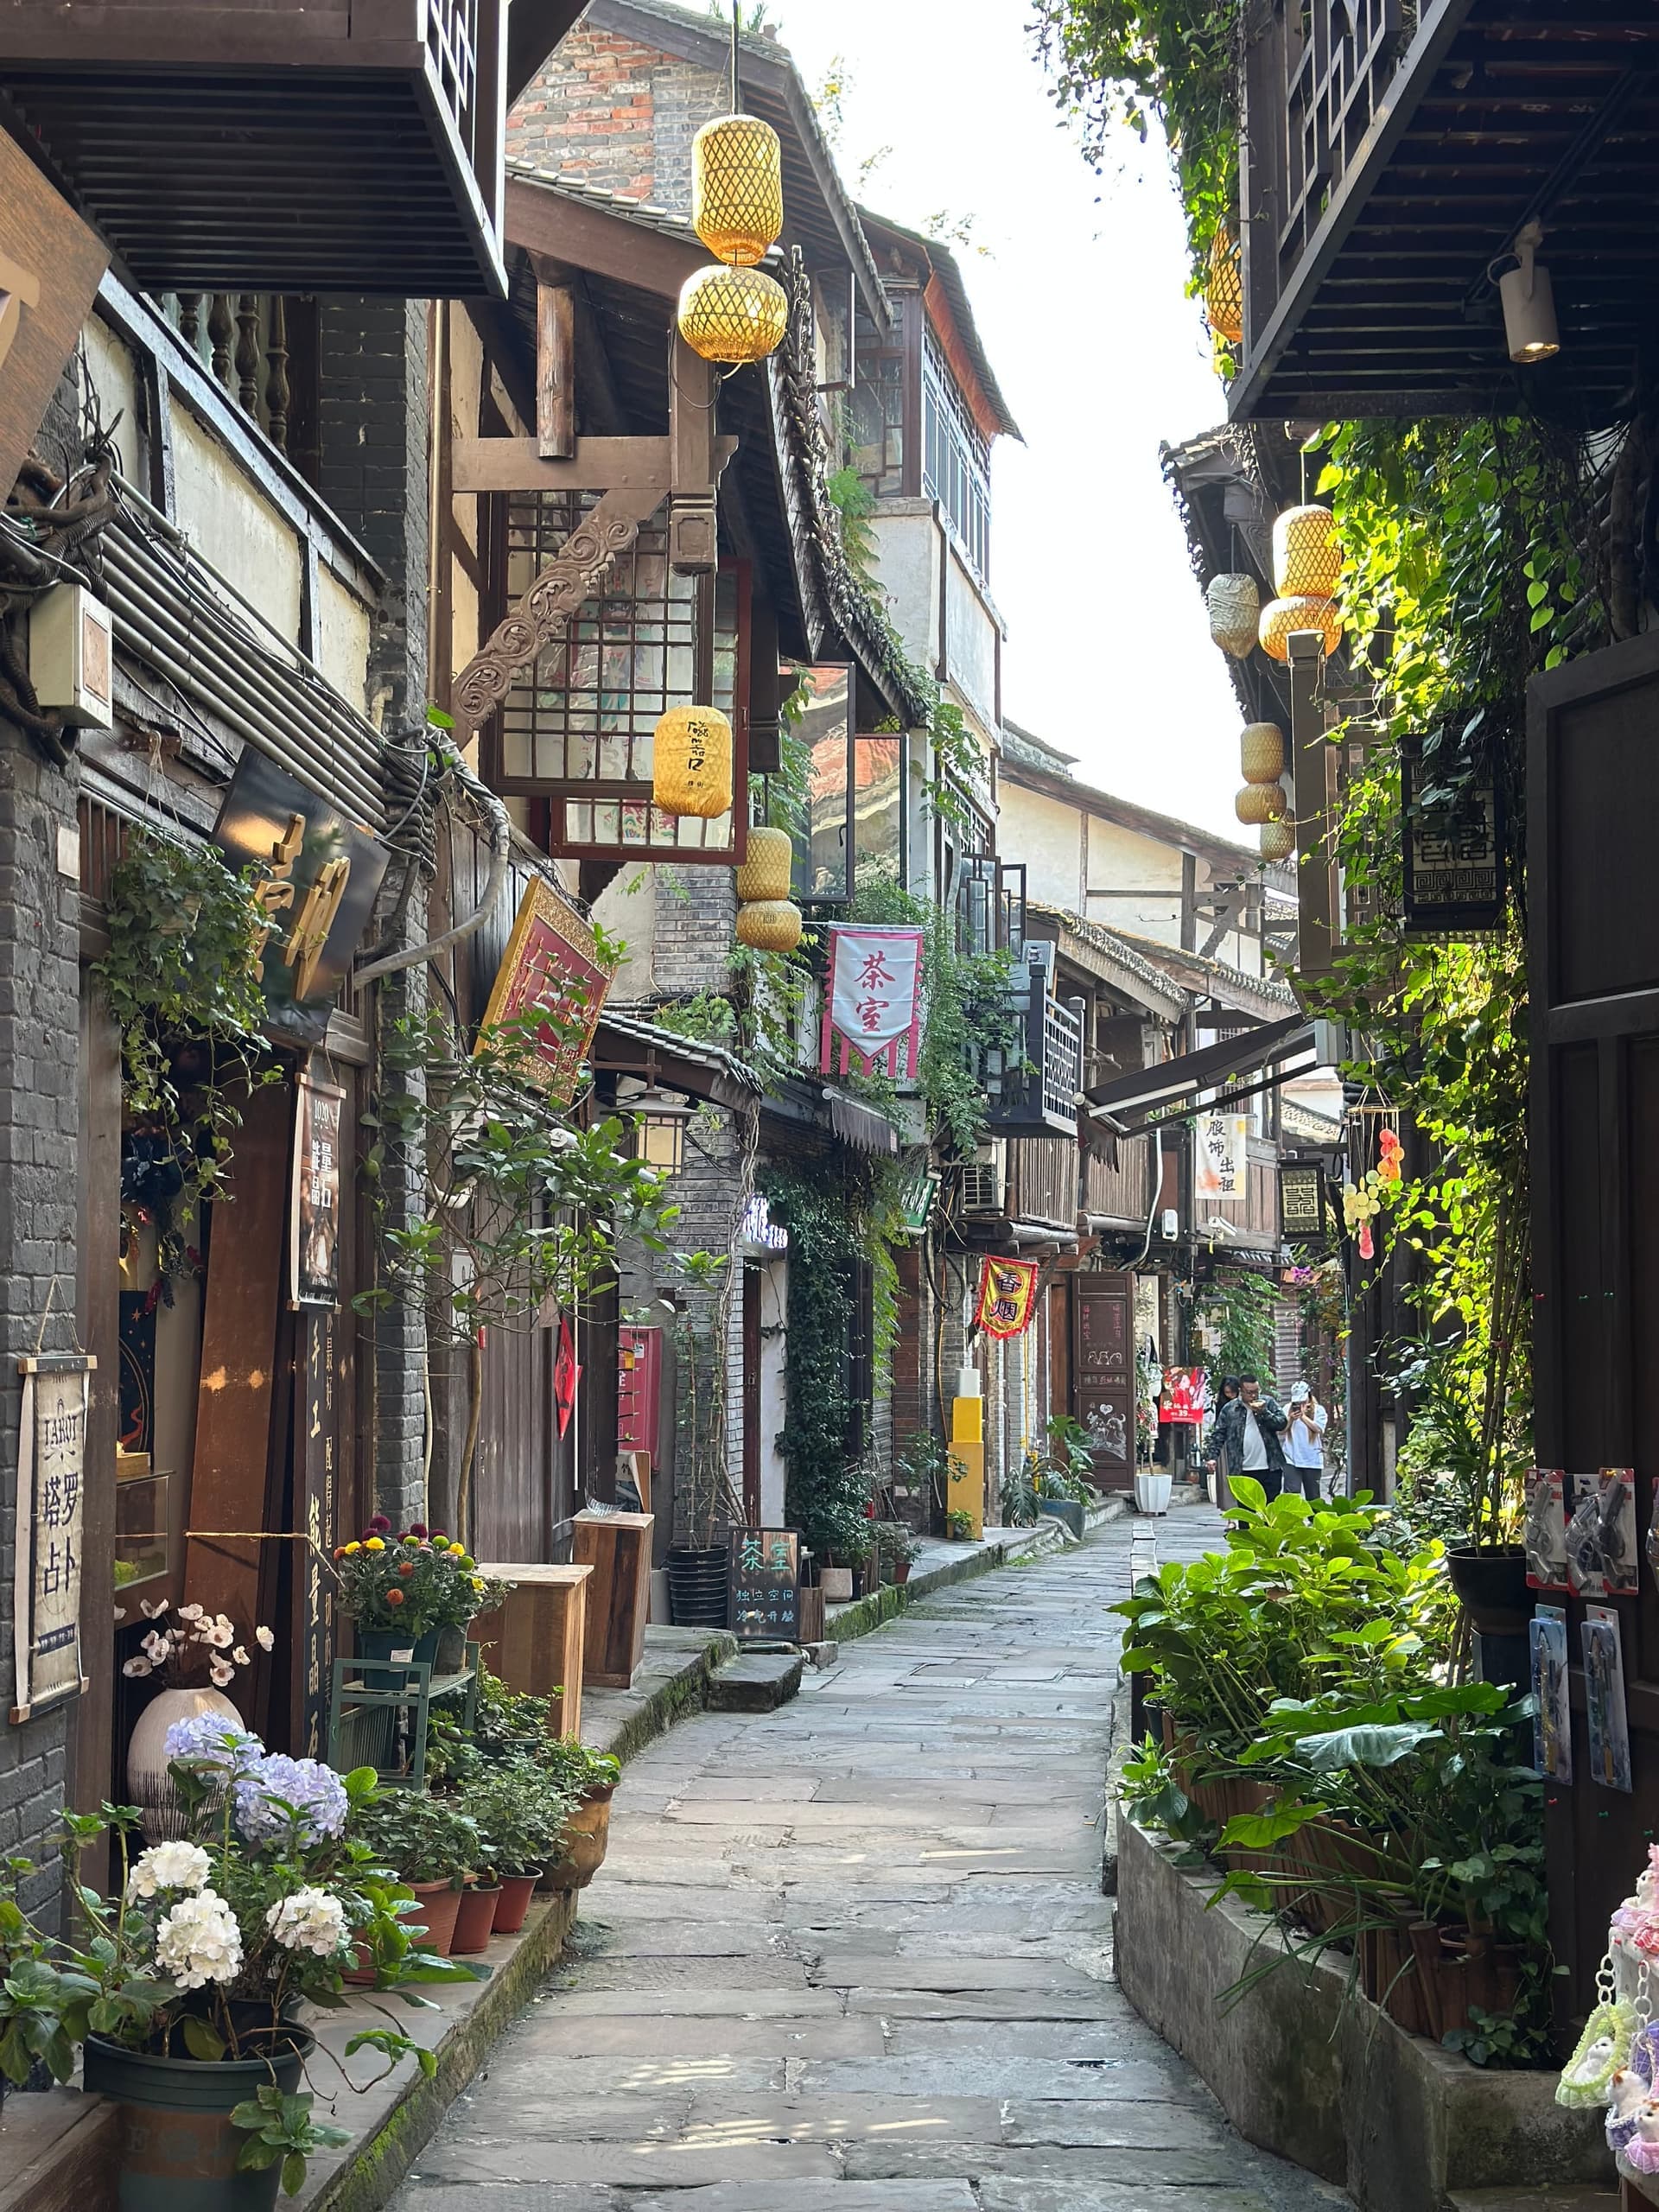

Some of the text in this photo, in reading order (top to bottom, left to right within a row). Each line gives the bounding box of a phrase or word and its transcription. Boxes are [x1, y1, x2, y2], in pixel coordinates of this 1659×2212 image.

[854, 950, 895, 1033] 茶室
[315, 1100, 329, 1122] 1020
[312, 1139, 333, 1173] 能量
[1206, 1120, 1236, 1192] 服饰出租
[989, 1270, 1022, 1322] 香烟
[44, 1414, 78, 1447] TAROT
[43, 1471, 79, 1529] 塔罗
[43, 1535, 76, 1596] 占卜
[738, 1539, 791, 1571] 茶室
[736, 1589, 794, 1603] 独立空间
[736, 1608, 794, 1624] 冷气开放
